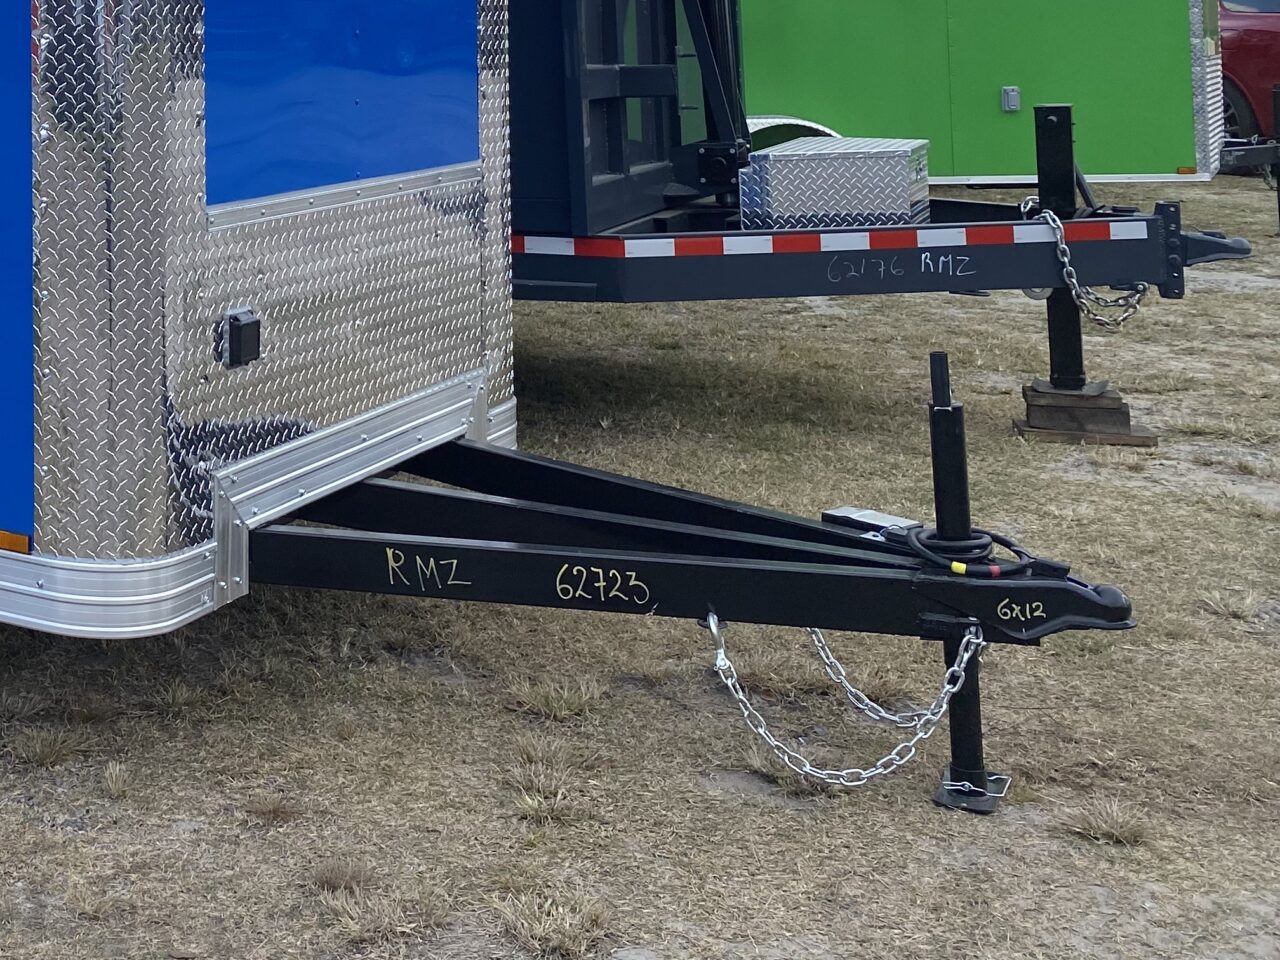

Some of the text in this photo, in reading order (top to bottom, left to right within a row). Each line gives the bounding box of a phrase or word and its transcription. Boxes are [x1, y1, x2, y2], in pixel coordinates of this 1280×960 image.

[827, 251, 977, 283] 62176 RMZ
[385, 547, 650, 605] RMZ 62723
